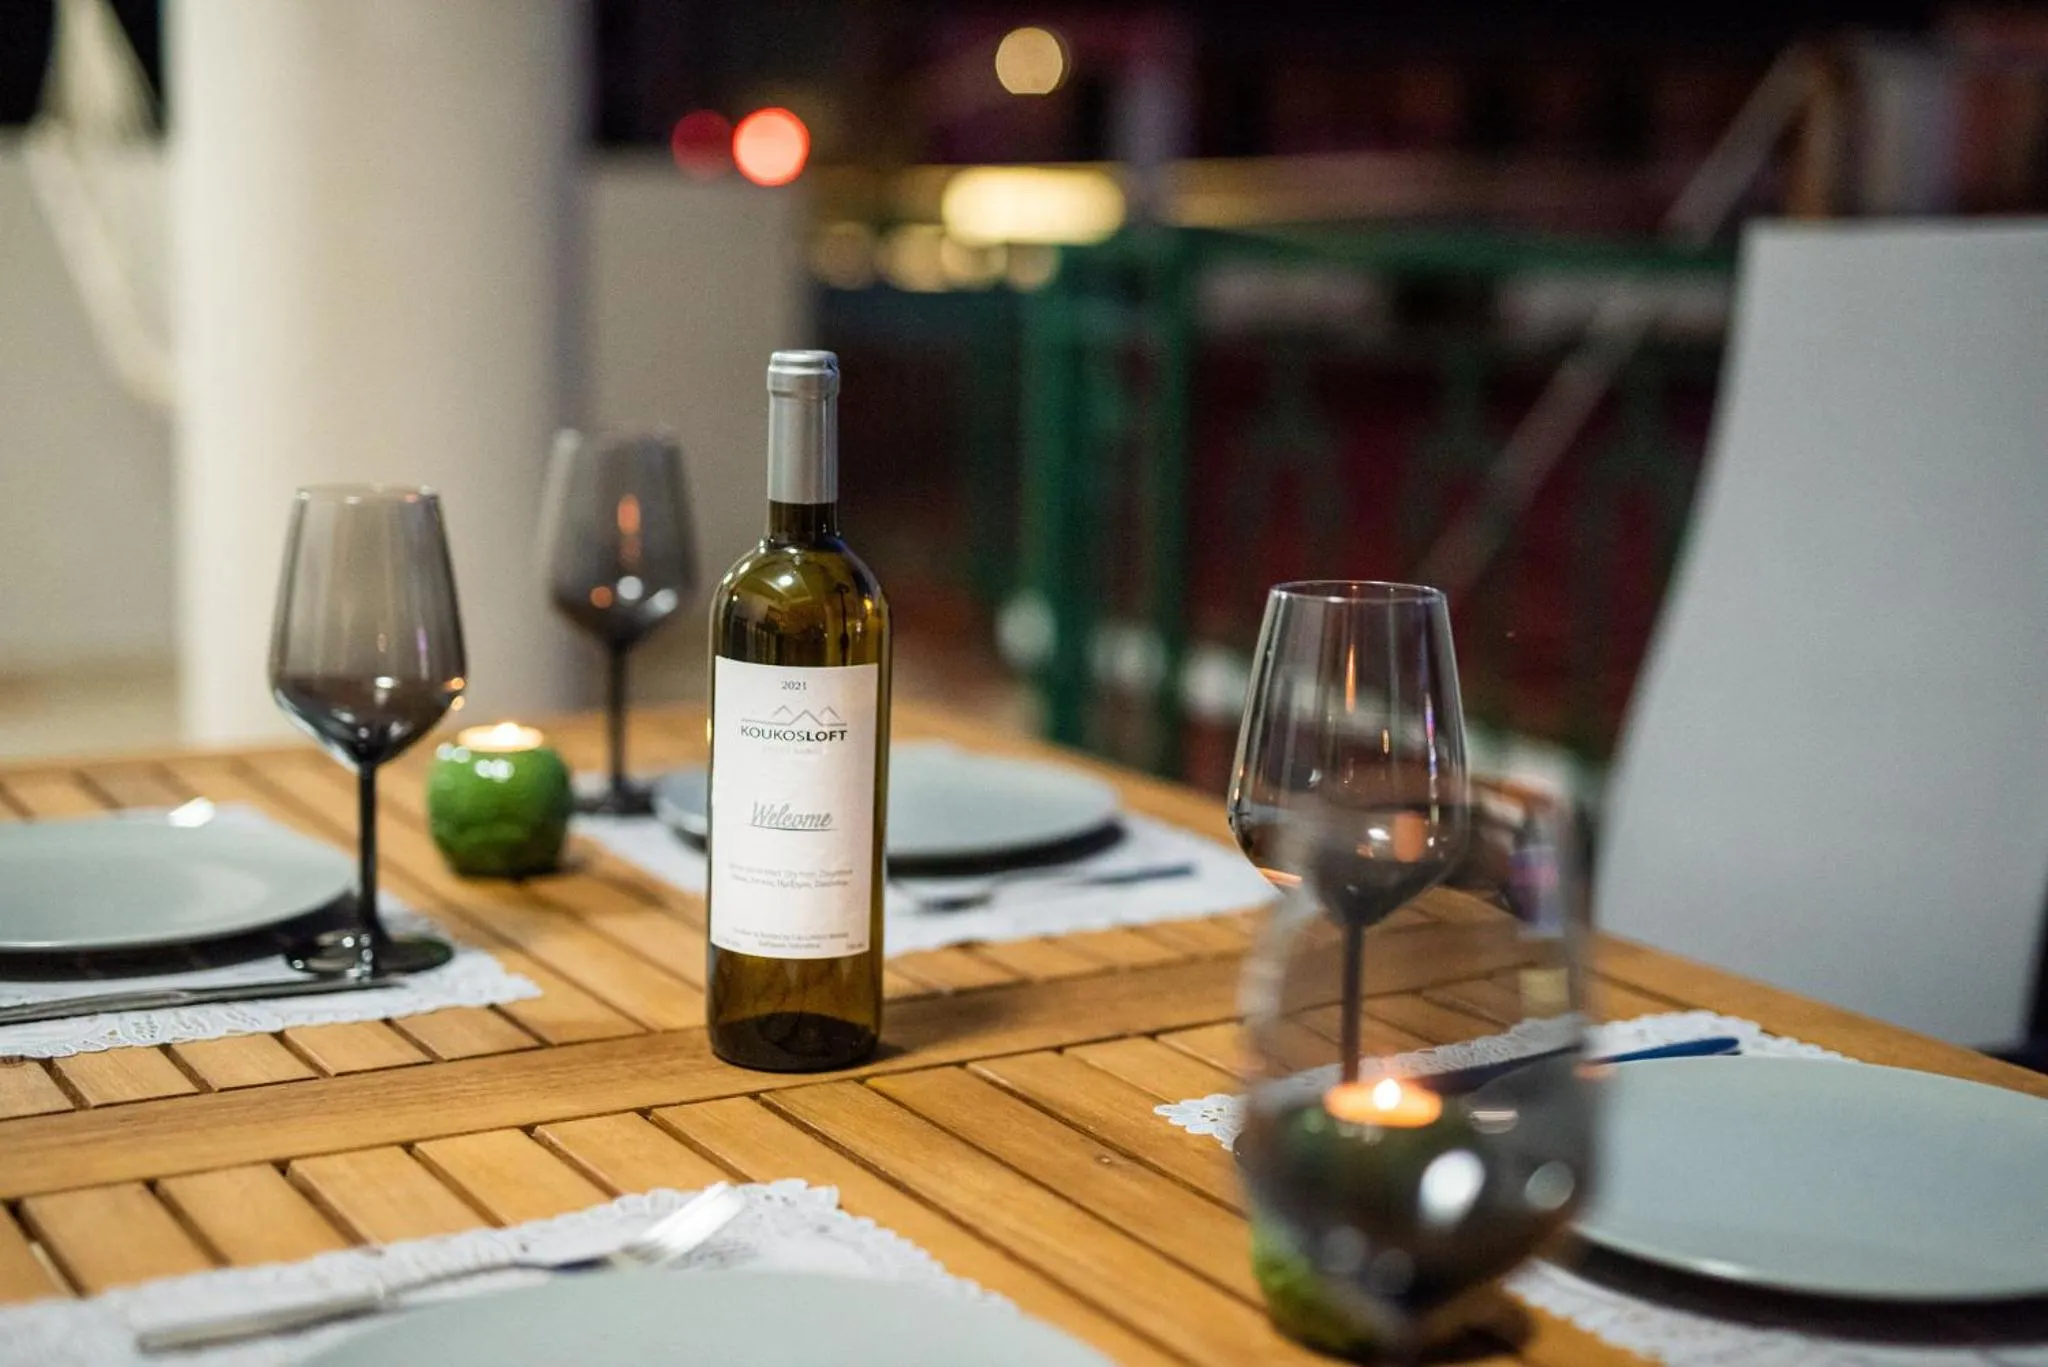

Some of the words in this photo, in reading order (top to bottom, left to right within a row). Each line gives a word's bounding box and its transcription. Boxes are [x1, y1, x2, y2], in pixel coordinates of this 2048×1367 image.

[781, 681, 807, 691] 2021
[740, 725, 848, 742] KOUKOSLOFT
[751, 801, 833, 829] Welcome
